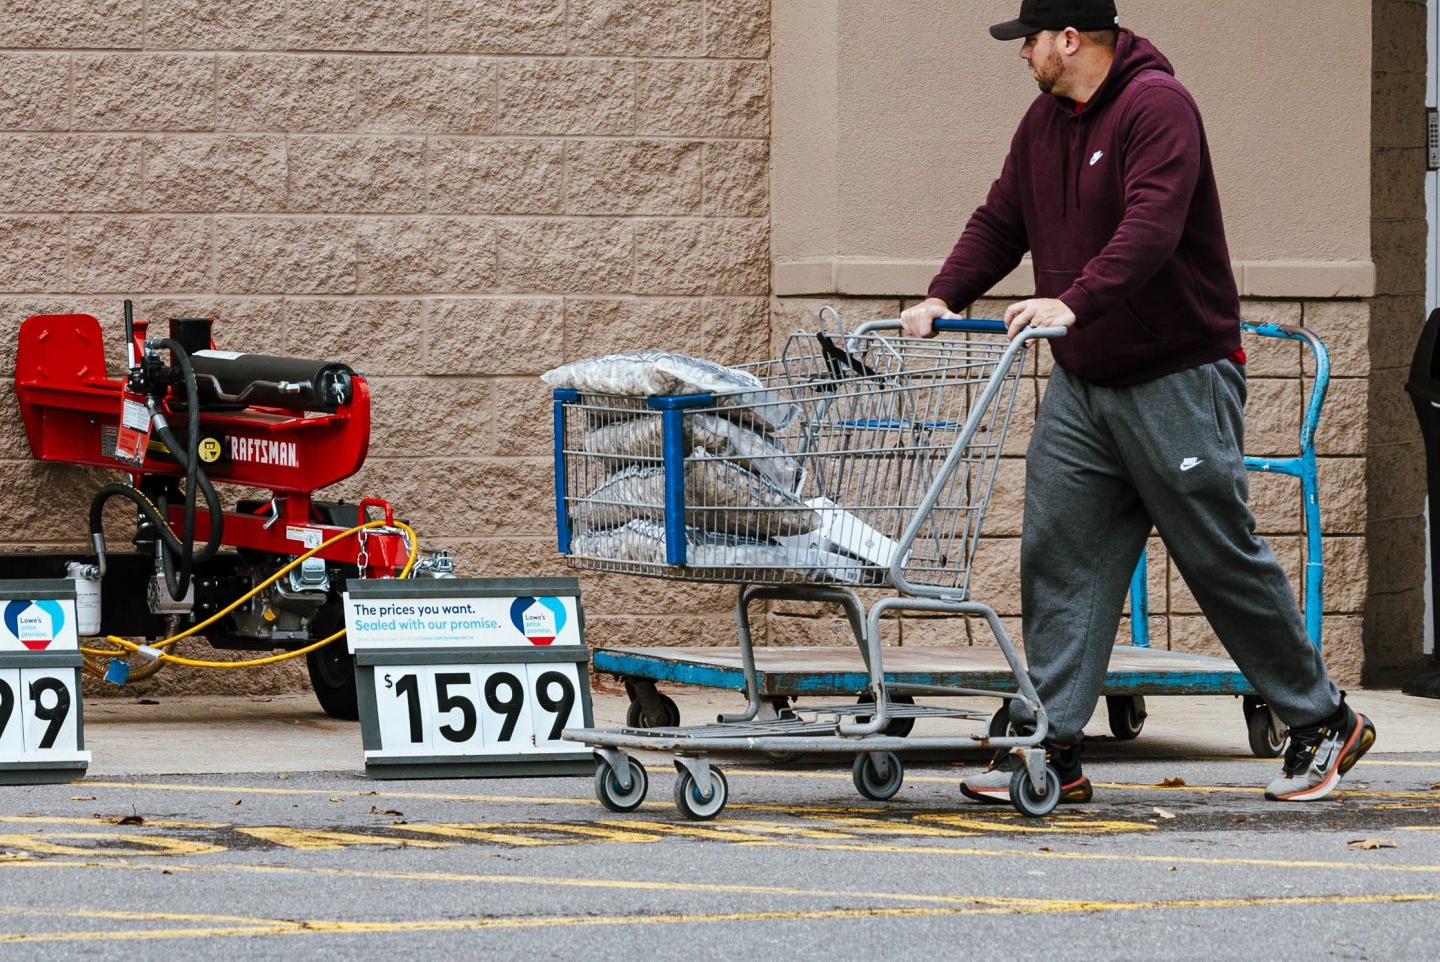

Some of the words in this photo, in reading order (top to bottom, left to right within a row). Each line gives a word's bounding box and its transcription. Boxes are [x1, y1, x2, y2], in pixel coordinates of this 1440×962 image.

[354, 604, 377, 615] The
[379, 603, 415, 617] prices
[418, 605, 439, 617] you
[442, 603, 476, 615] want.
[355, 619, 396, 631] Sealed
[399, 618, 426, 630] with
[428, 621, 448, 630] our
[450, 617, 502, 632] promise.
[384, 670, 576, 744] $1599
